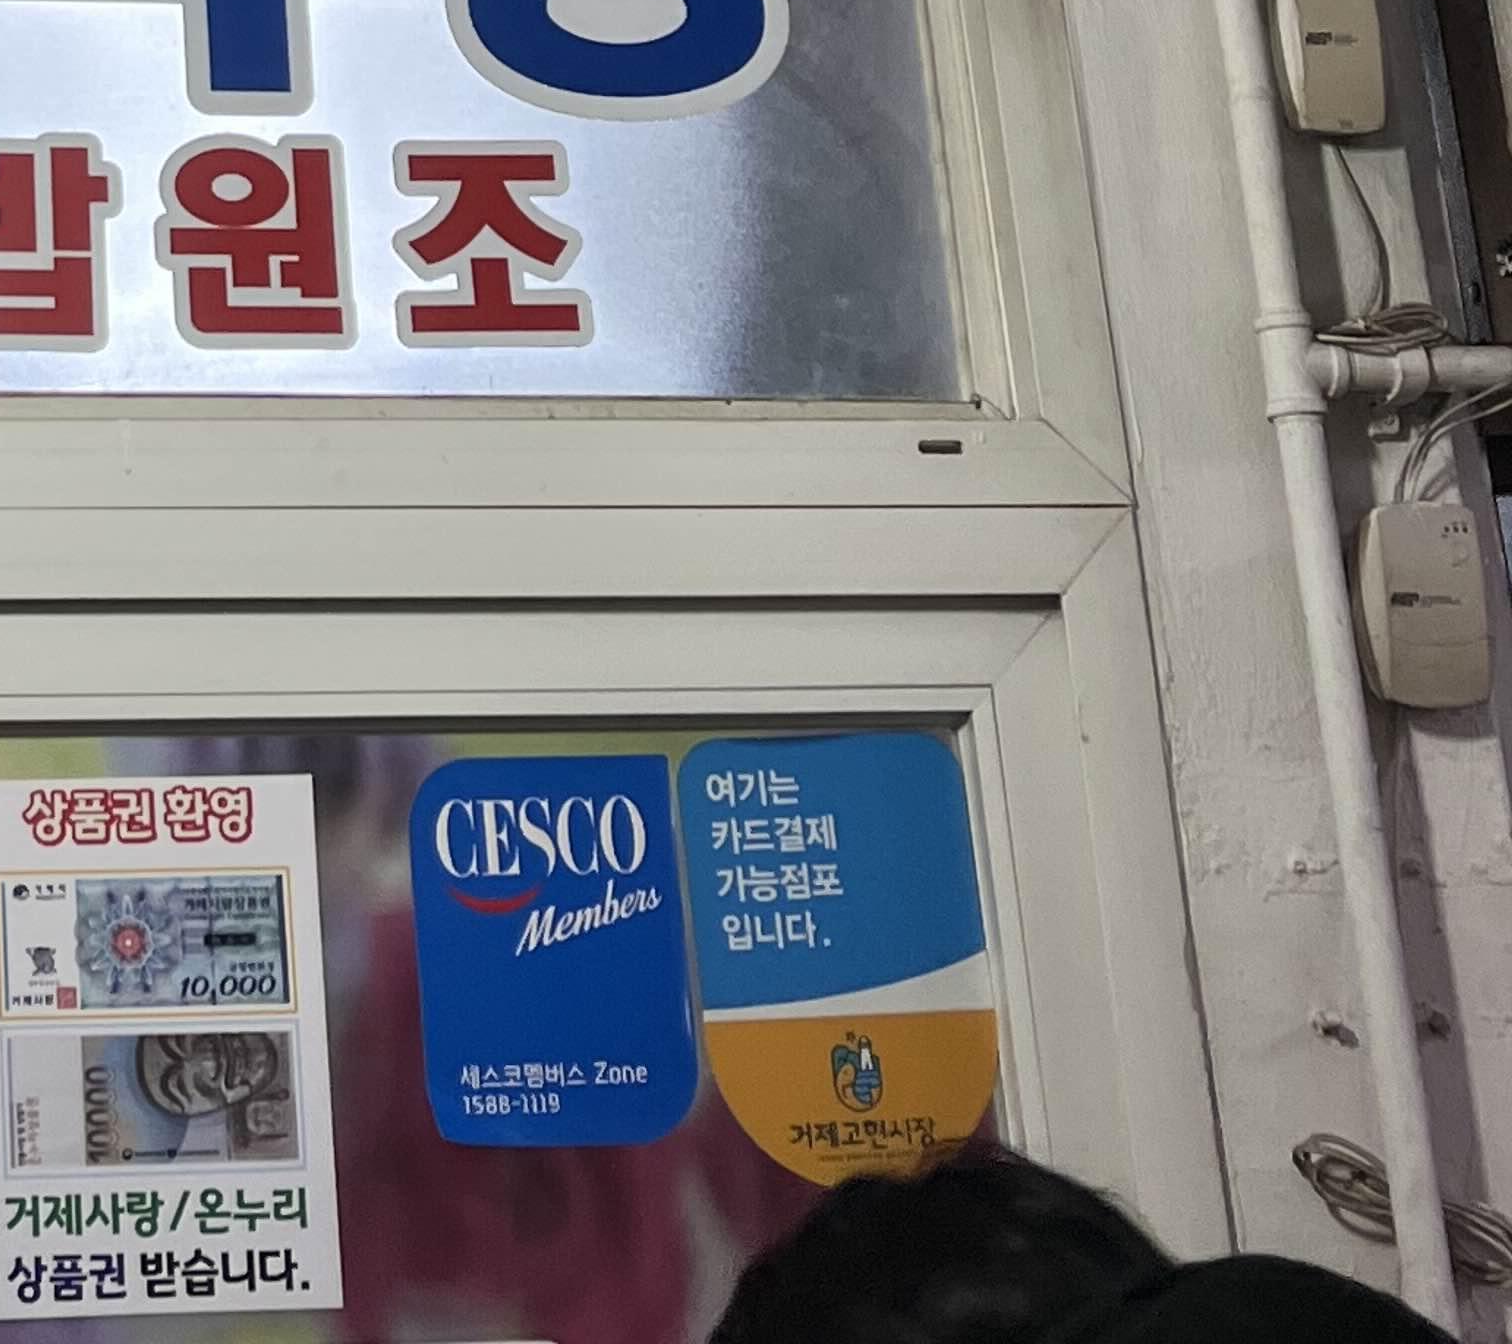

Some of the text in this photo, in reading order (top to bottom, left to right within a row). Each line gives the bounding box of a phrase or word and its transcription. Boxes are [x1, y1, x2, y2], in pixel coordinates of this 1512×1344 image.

[706, 770, 799, 806] 여기는
[23, 787, 253, 847] 상품권 환영
[712, 815, 837, 853] 카드결제
[434, 795, 646, 880] CESCO
[717, 863, 843, 901] 가능점포
[515, 878, 662, 956] Members
[722, 911, 832, 950] 입니다.
[181, 975, 276, 1004] 10,000
[460, 1061, 648, 1089] 세스코멤버스 Zone
[463, 1093, 561, 1115] 1588-1119
[789, 1115, 936, 1149] 거제고현시장
[7, 1248, 311, 1304] 상품권 받습니다.
